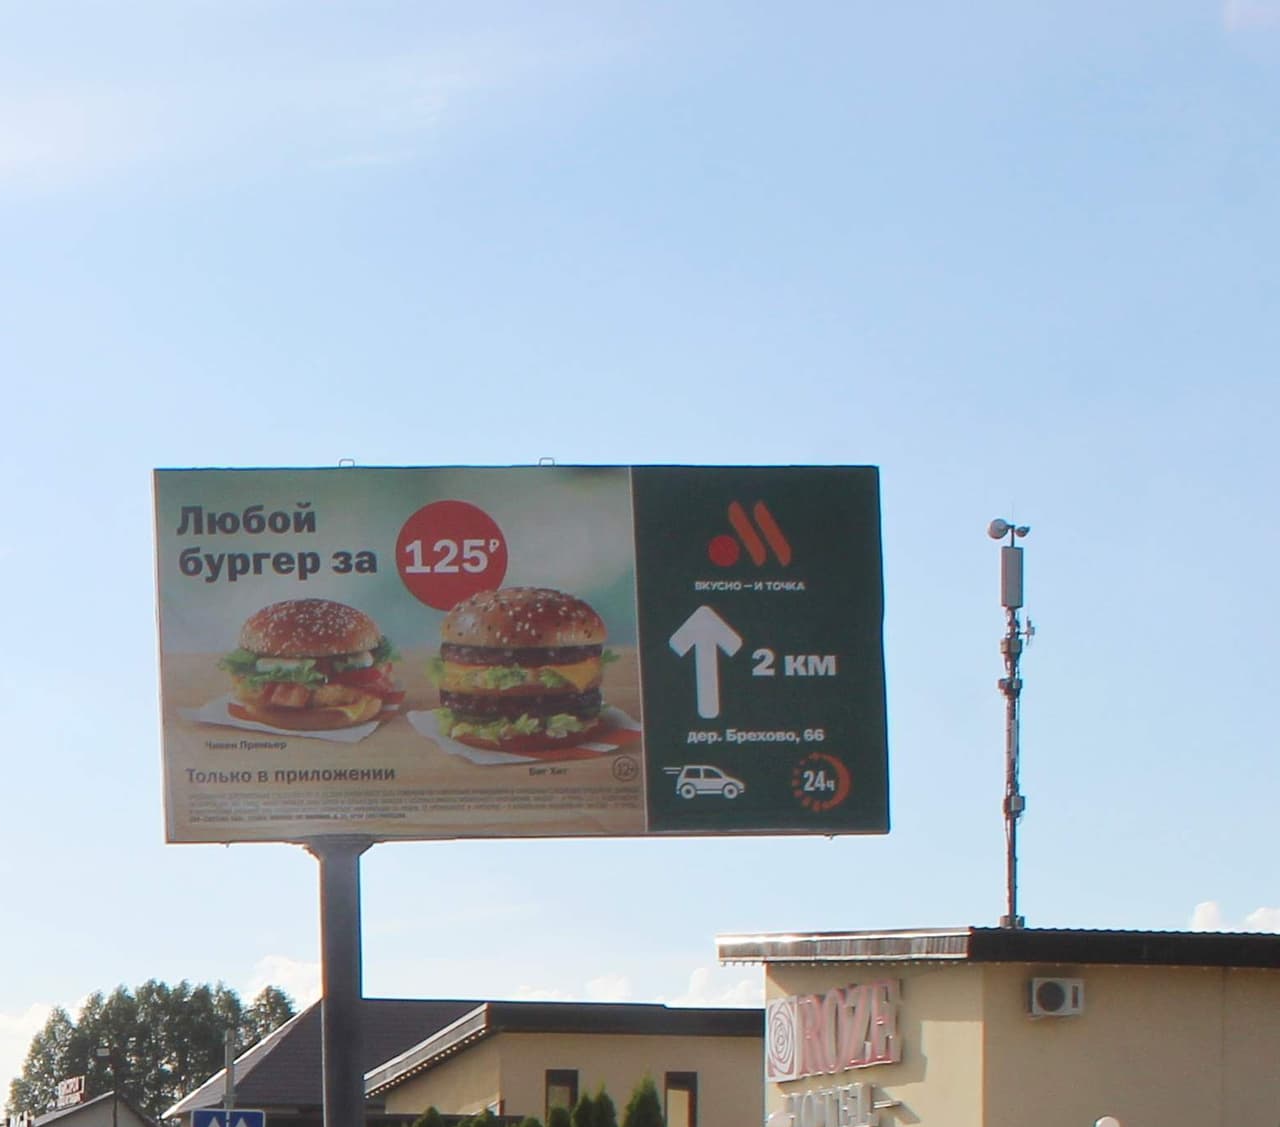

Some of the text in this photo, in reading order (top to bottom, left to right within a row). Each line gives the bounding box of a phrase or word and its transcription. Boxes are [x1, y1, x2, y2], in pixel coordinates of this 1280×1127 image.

[176, 501, 317, 536] Любой
[178, 547, 378, 584] бургер за
[695, 581, 742, 591] ВКУСНО
[766, 581, 806, 591] ТОЧКА
[752, 648, 837, 677] 2 км
[687, 728, 825, 744] дер. Брехово, 66
[186, 766, 396, 785] Только в приложении
